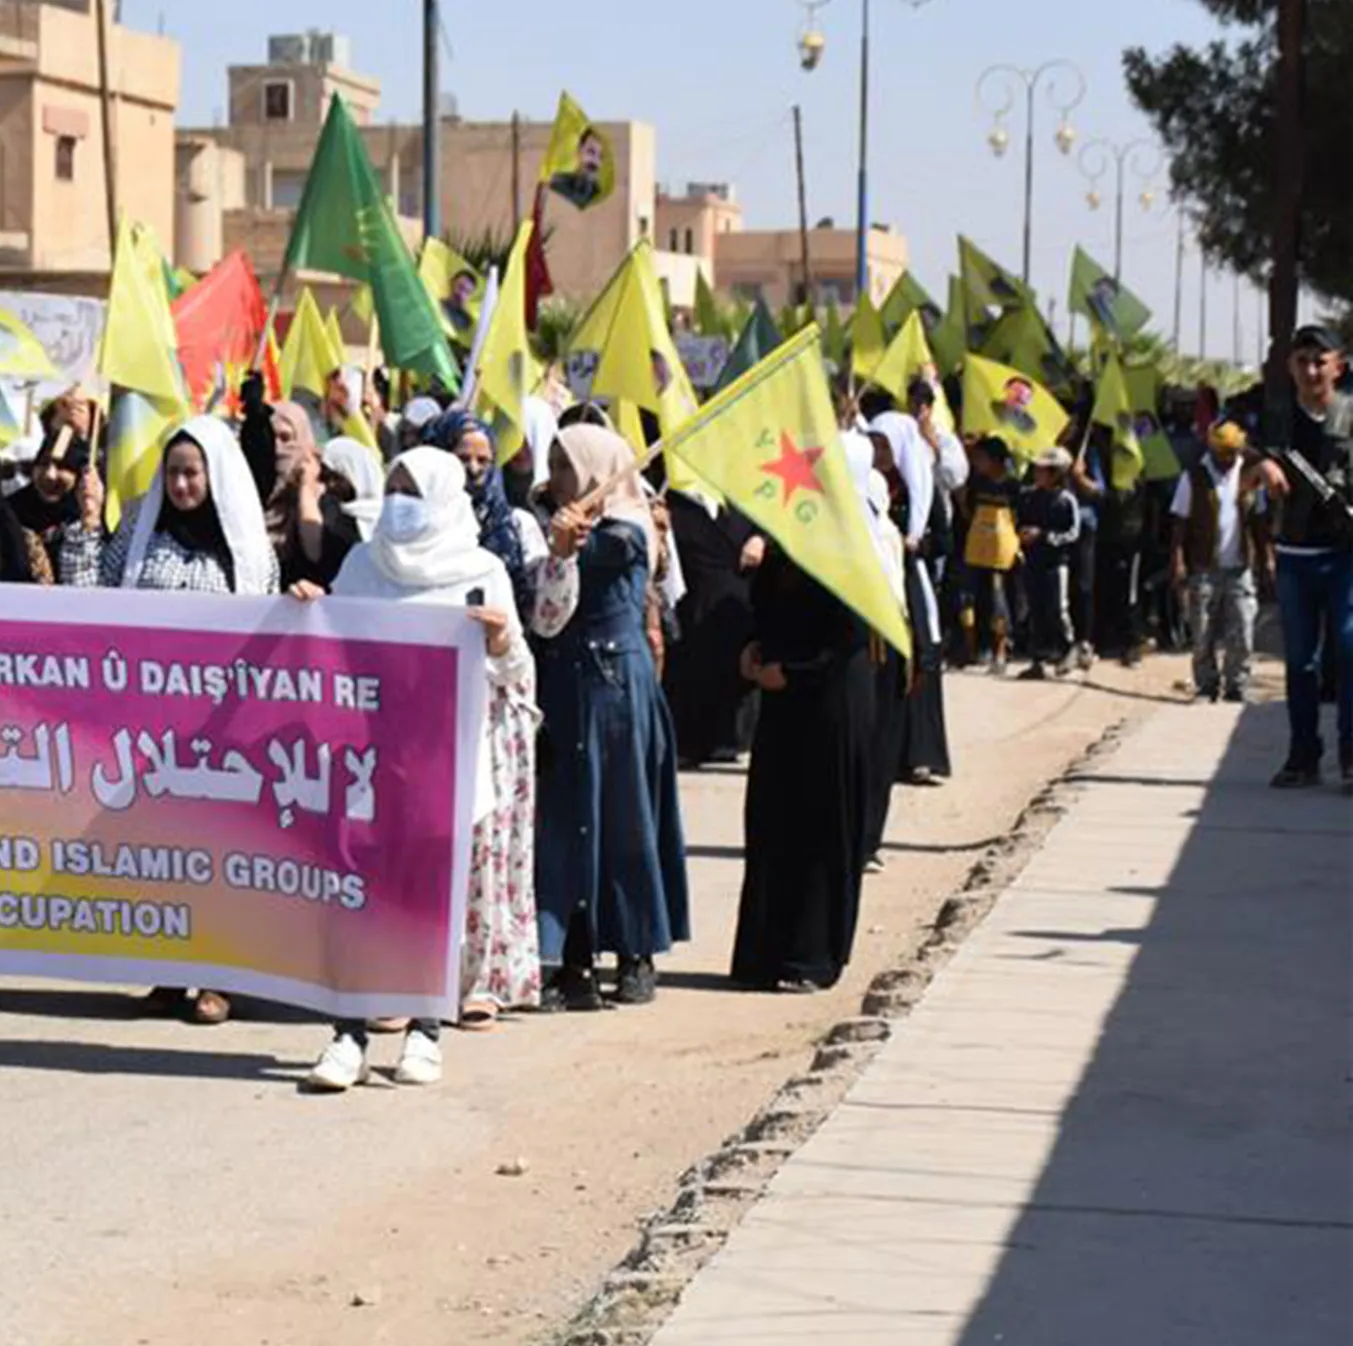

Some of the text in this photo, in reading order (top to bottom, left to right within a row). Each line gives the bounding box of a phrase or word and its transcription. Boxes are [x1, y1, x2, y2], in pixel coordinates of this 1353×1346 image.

[102, 647, 127, 691] Û
[333, 673, 380, 710] RE
[91, 726, 331, 828] للإحتلال
[343, 745, 377, 822] لا
[51, 838, 213, 884] ISLAMIC
[225, 853, 367, 909] GROUPS
